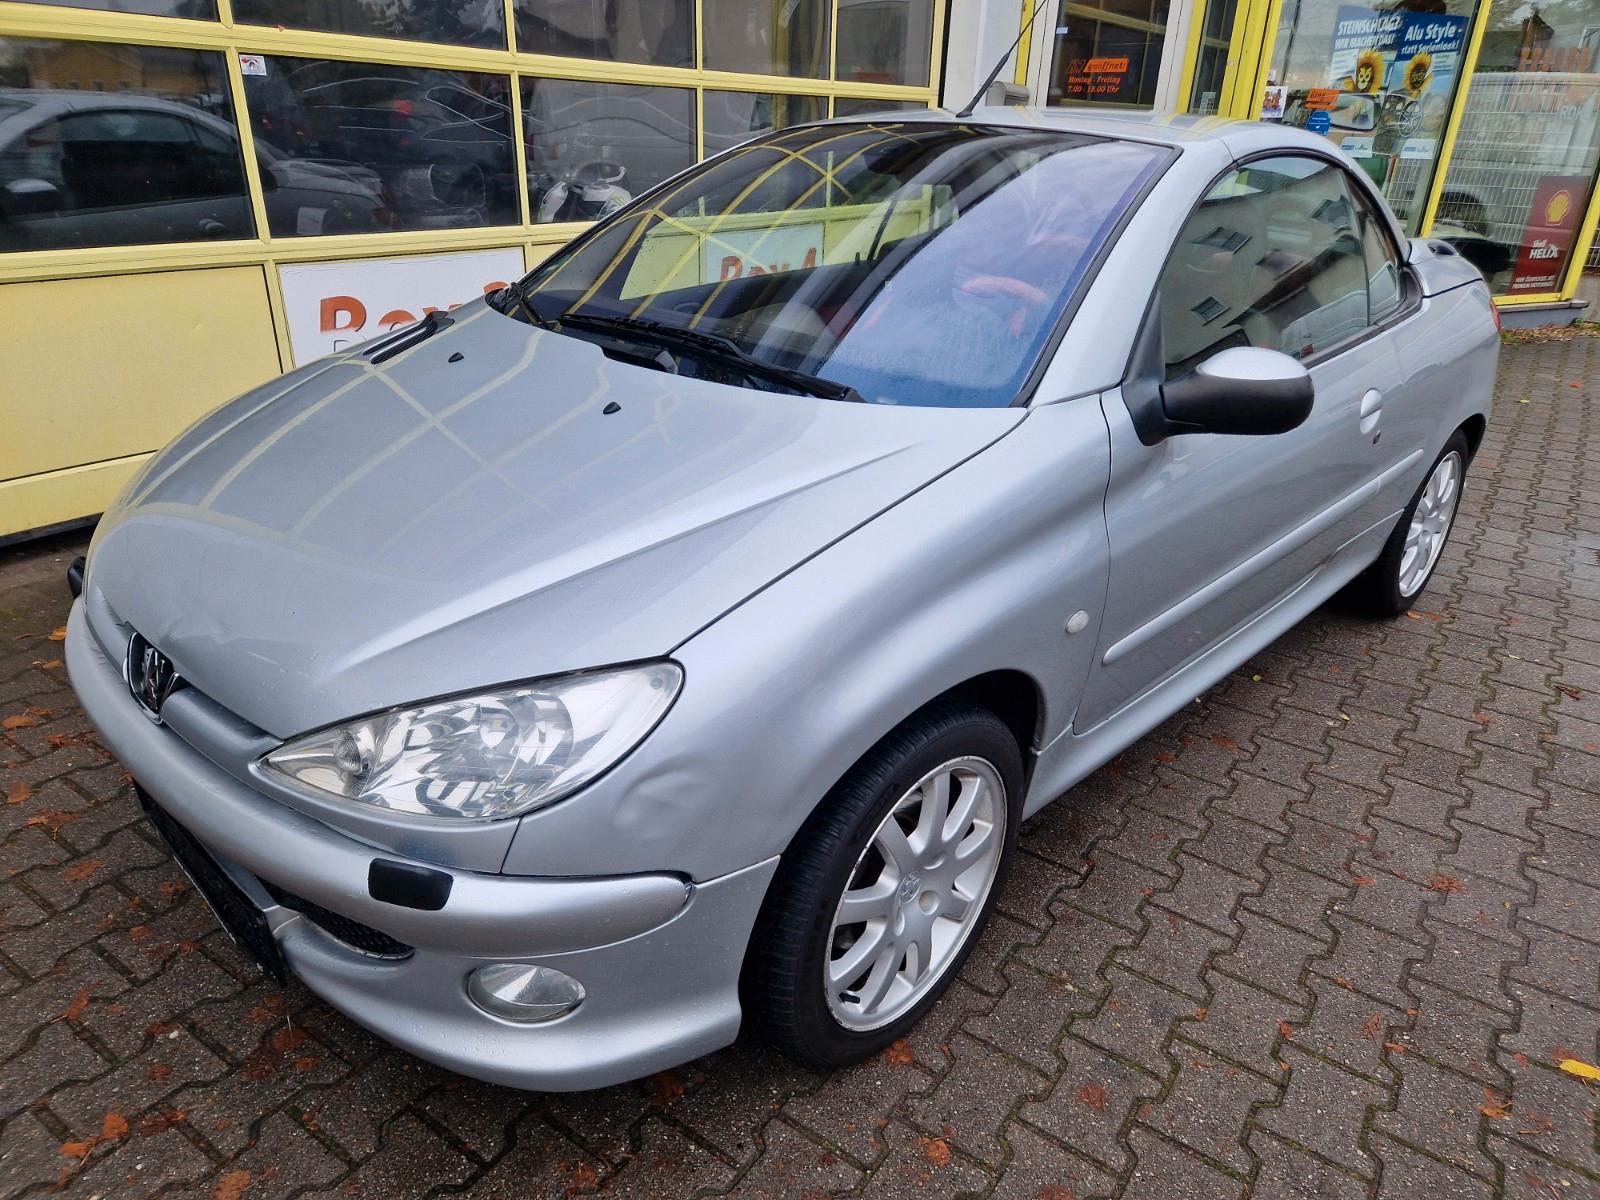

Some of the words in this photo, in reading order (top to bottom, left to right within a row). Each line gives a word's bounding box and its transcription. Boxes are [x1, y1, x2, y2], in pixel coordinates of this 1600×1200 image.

[1404, 24, 1425, 42] Alu
[1425, 21, 1456, 43] Style
[1401, 43, 1419, 55] statt
[1068, 76, 1092, 84] Montag
[1097, 76, 1121, 84] Freitag
[1529, 246, 1559, 259] HELIX
